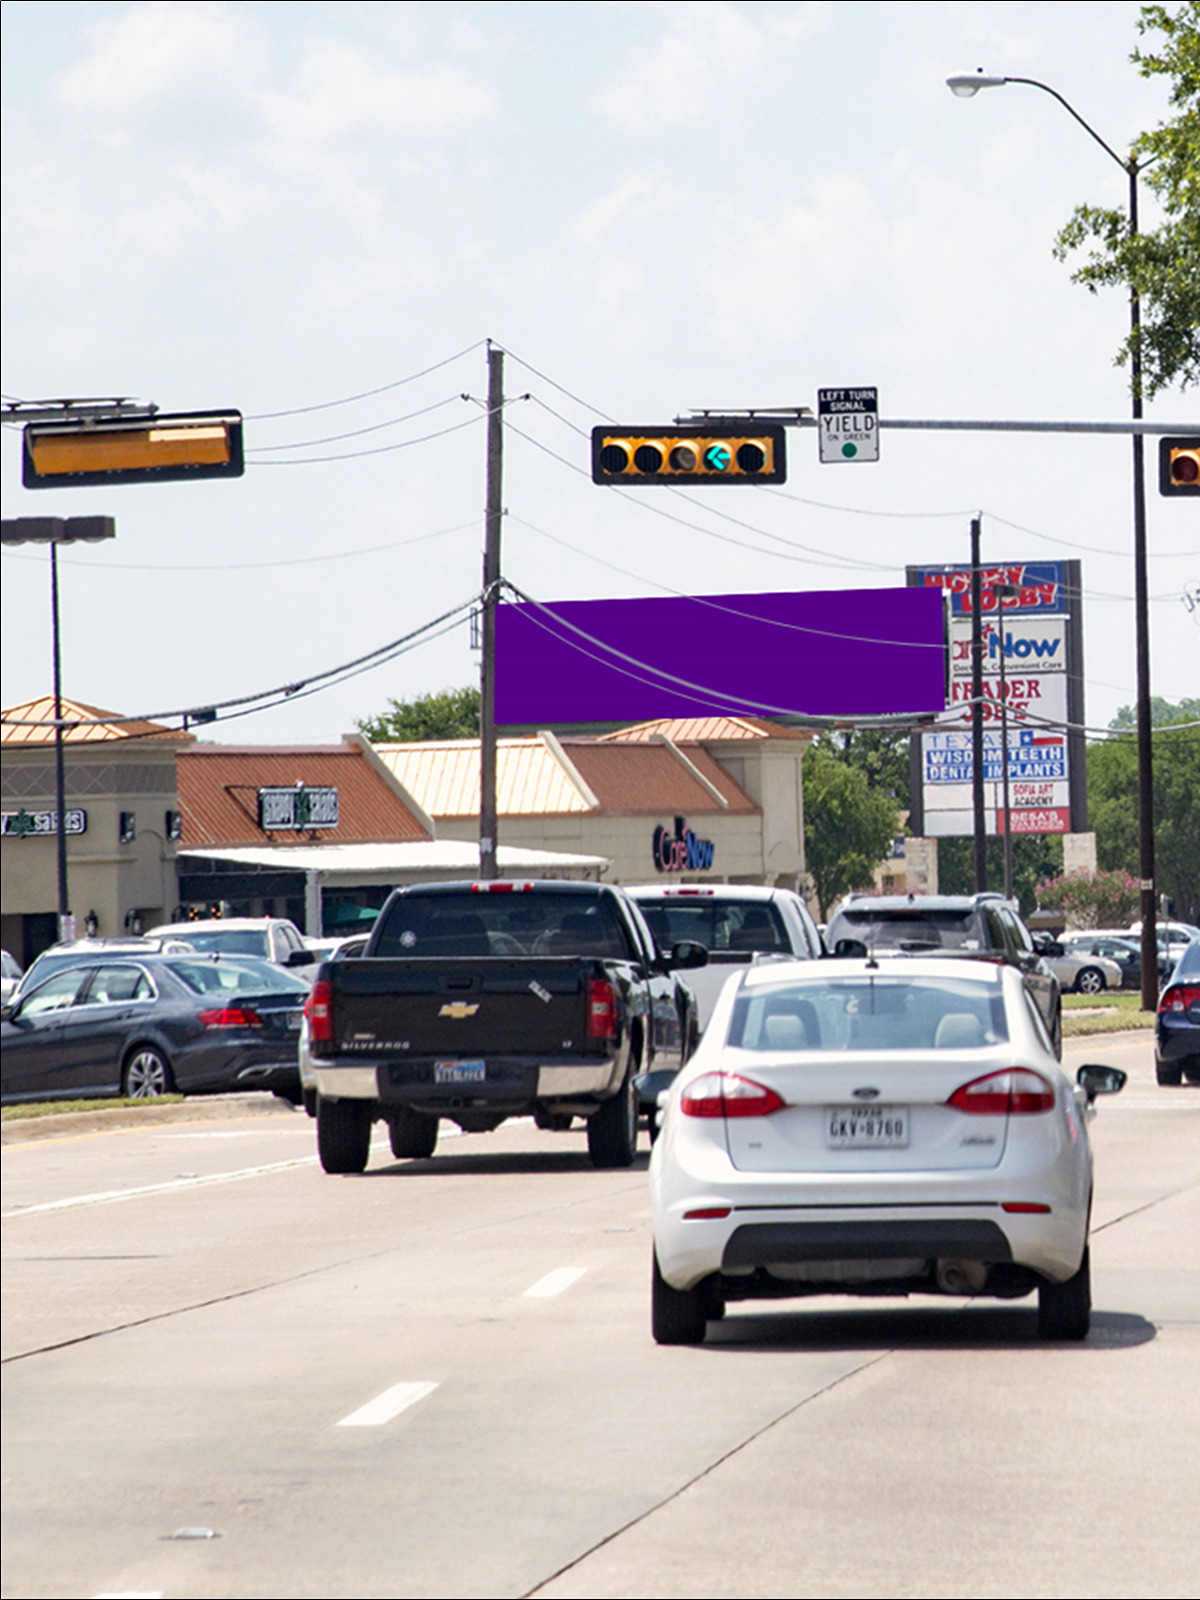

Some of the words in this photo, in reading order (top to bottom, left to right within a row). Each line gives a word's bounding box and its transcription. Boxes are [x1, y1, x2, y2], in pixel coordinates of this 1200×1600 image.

[820, 391, 846, 401] LEFT
[848, 389, 876, 400] TURN
[829, 401, 866, 412] SIGNAL
[823, 415, 875, 432] YIELD
[843, 433, 871, 441] GREEN
[1042, 661, 1062, 669] Care
[930, 751, 1003, 764] WISDM
[1010, 747, 1061, 760] TEETH
[930, 766, 974, 780] DENTA
[1013, 784, 1036, 795] SOFIA
[1038, 784, 1053, 794] ART
[1014, 796, 1054, 806] ACADEMY
